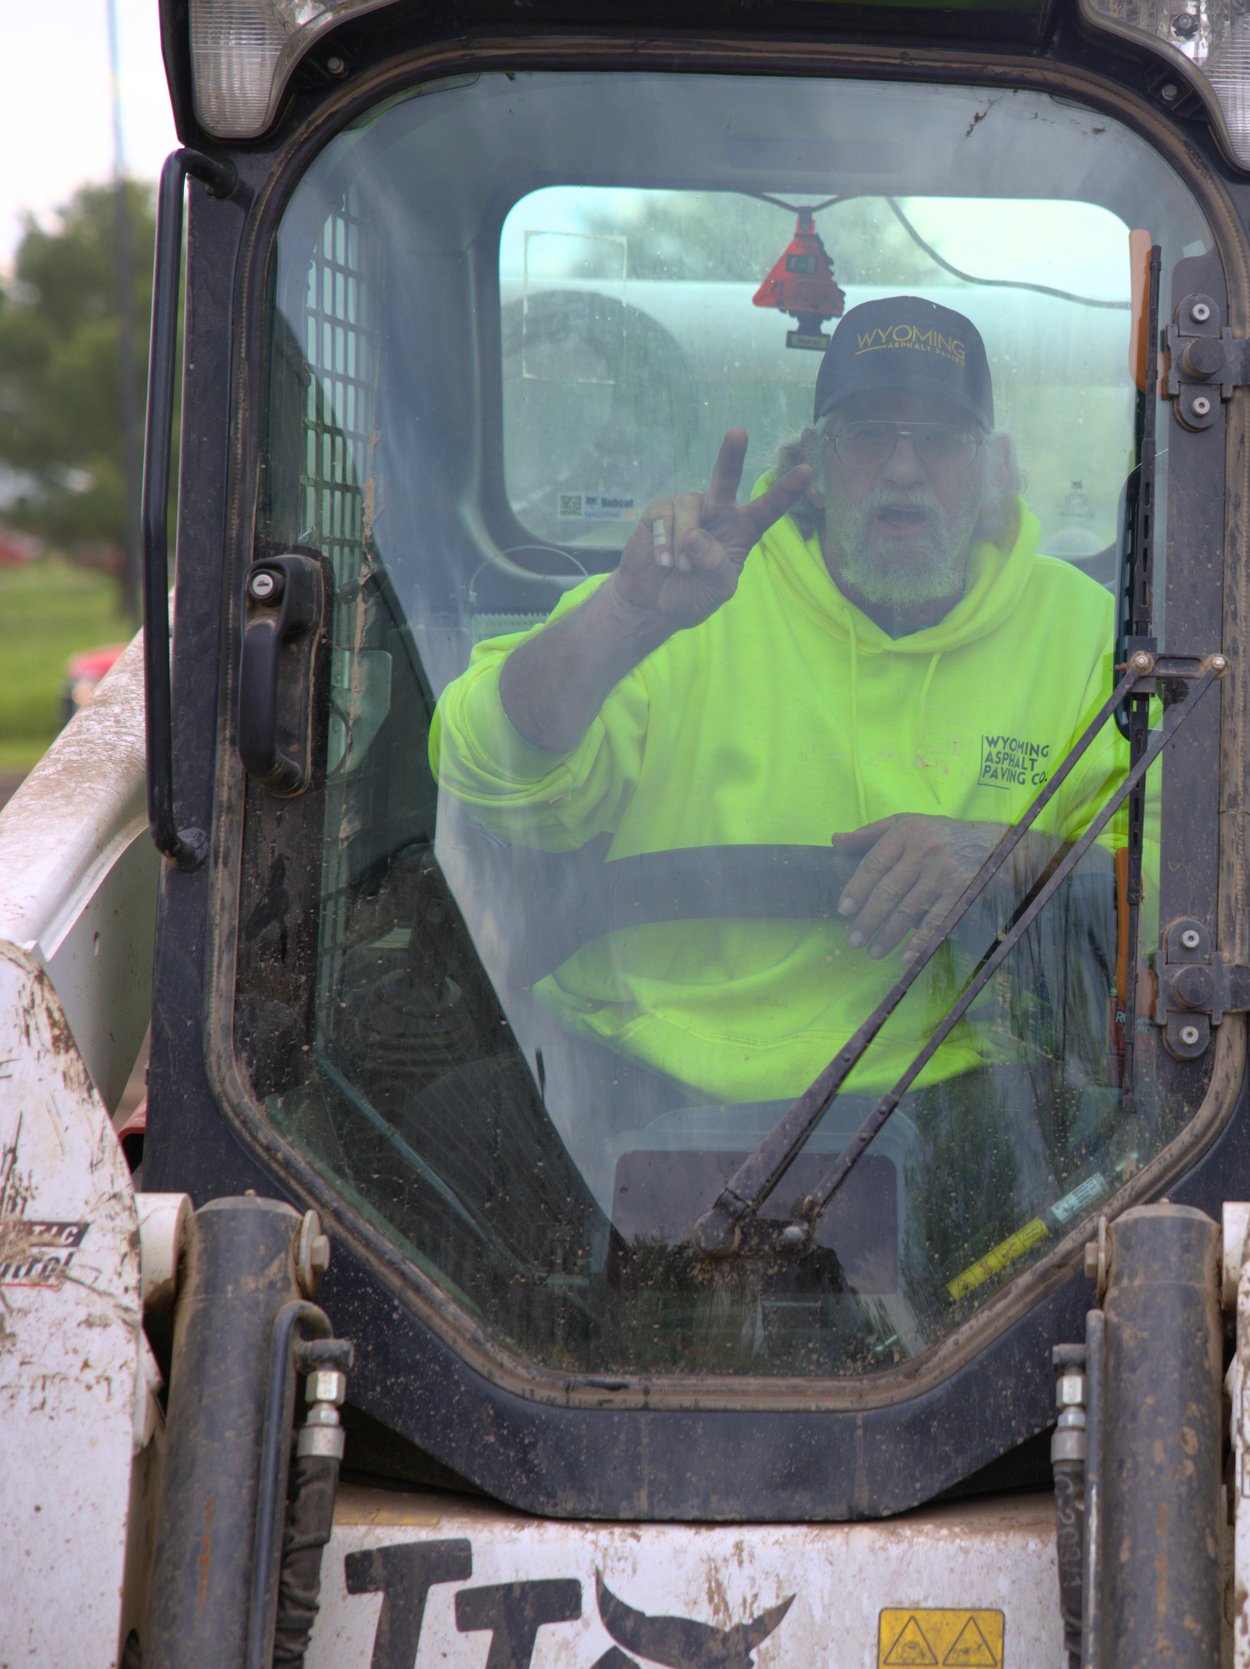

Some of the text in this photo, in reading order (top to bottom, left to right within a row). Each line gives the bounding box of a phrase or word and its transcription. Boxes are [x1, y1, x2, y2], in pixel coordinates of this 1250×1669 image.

[857, 324, 965, 359] WYOMING
[887, 342, 931, 352] ASPHALT
[985, 736, 1050, 758] WYOMING
[984, 750, 1038, 772] ASPHALT
[982, 764, 1026, 785] PAVING
